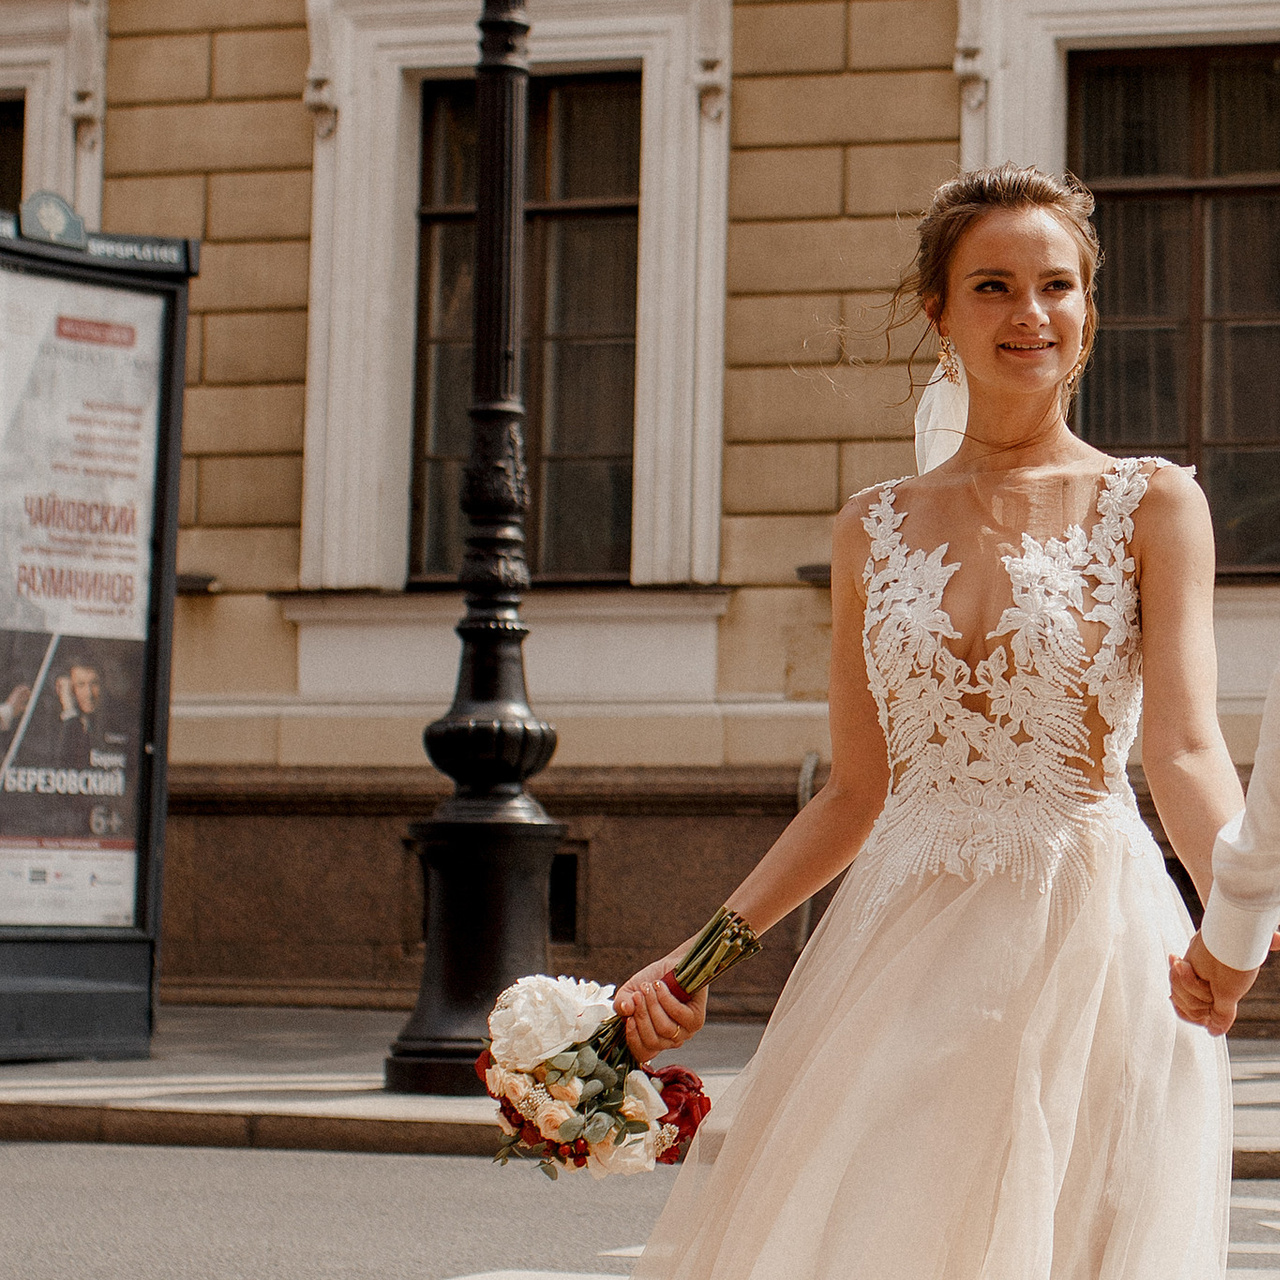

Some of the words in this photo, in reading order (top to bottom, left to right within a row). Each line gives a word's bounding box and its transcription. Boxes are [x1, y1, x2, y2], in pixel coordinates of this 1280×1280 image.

[24, 490, 137, 535] ЧАЙКОВСКИЙ
[16, 564, 134, 604] РАХМАНИНОВ
[4, 767, 126, 796] БЕРЕЗОВСКИЙ
[89, 805, 122, 835] 6+
